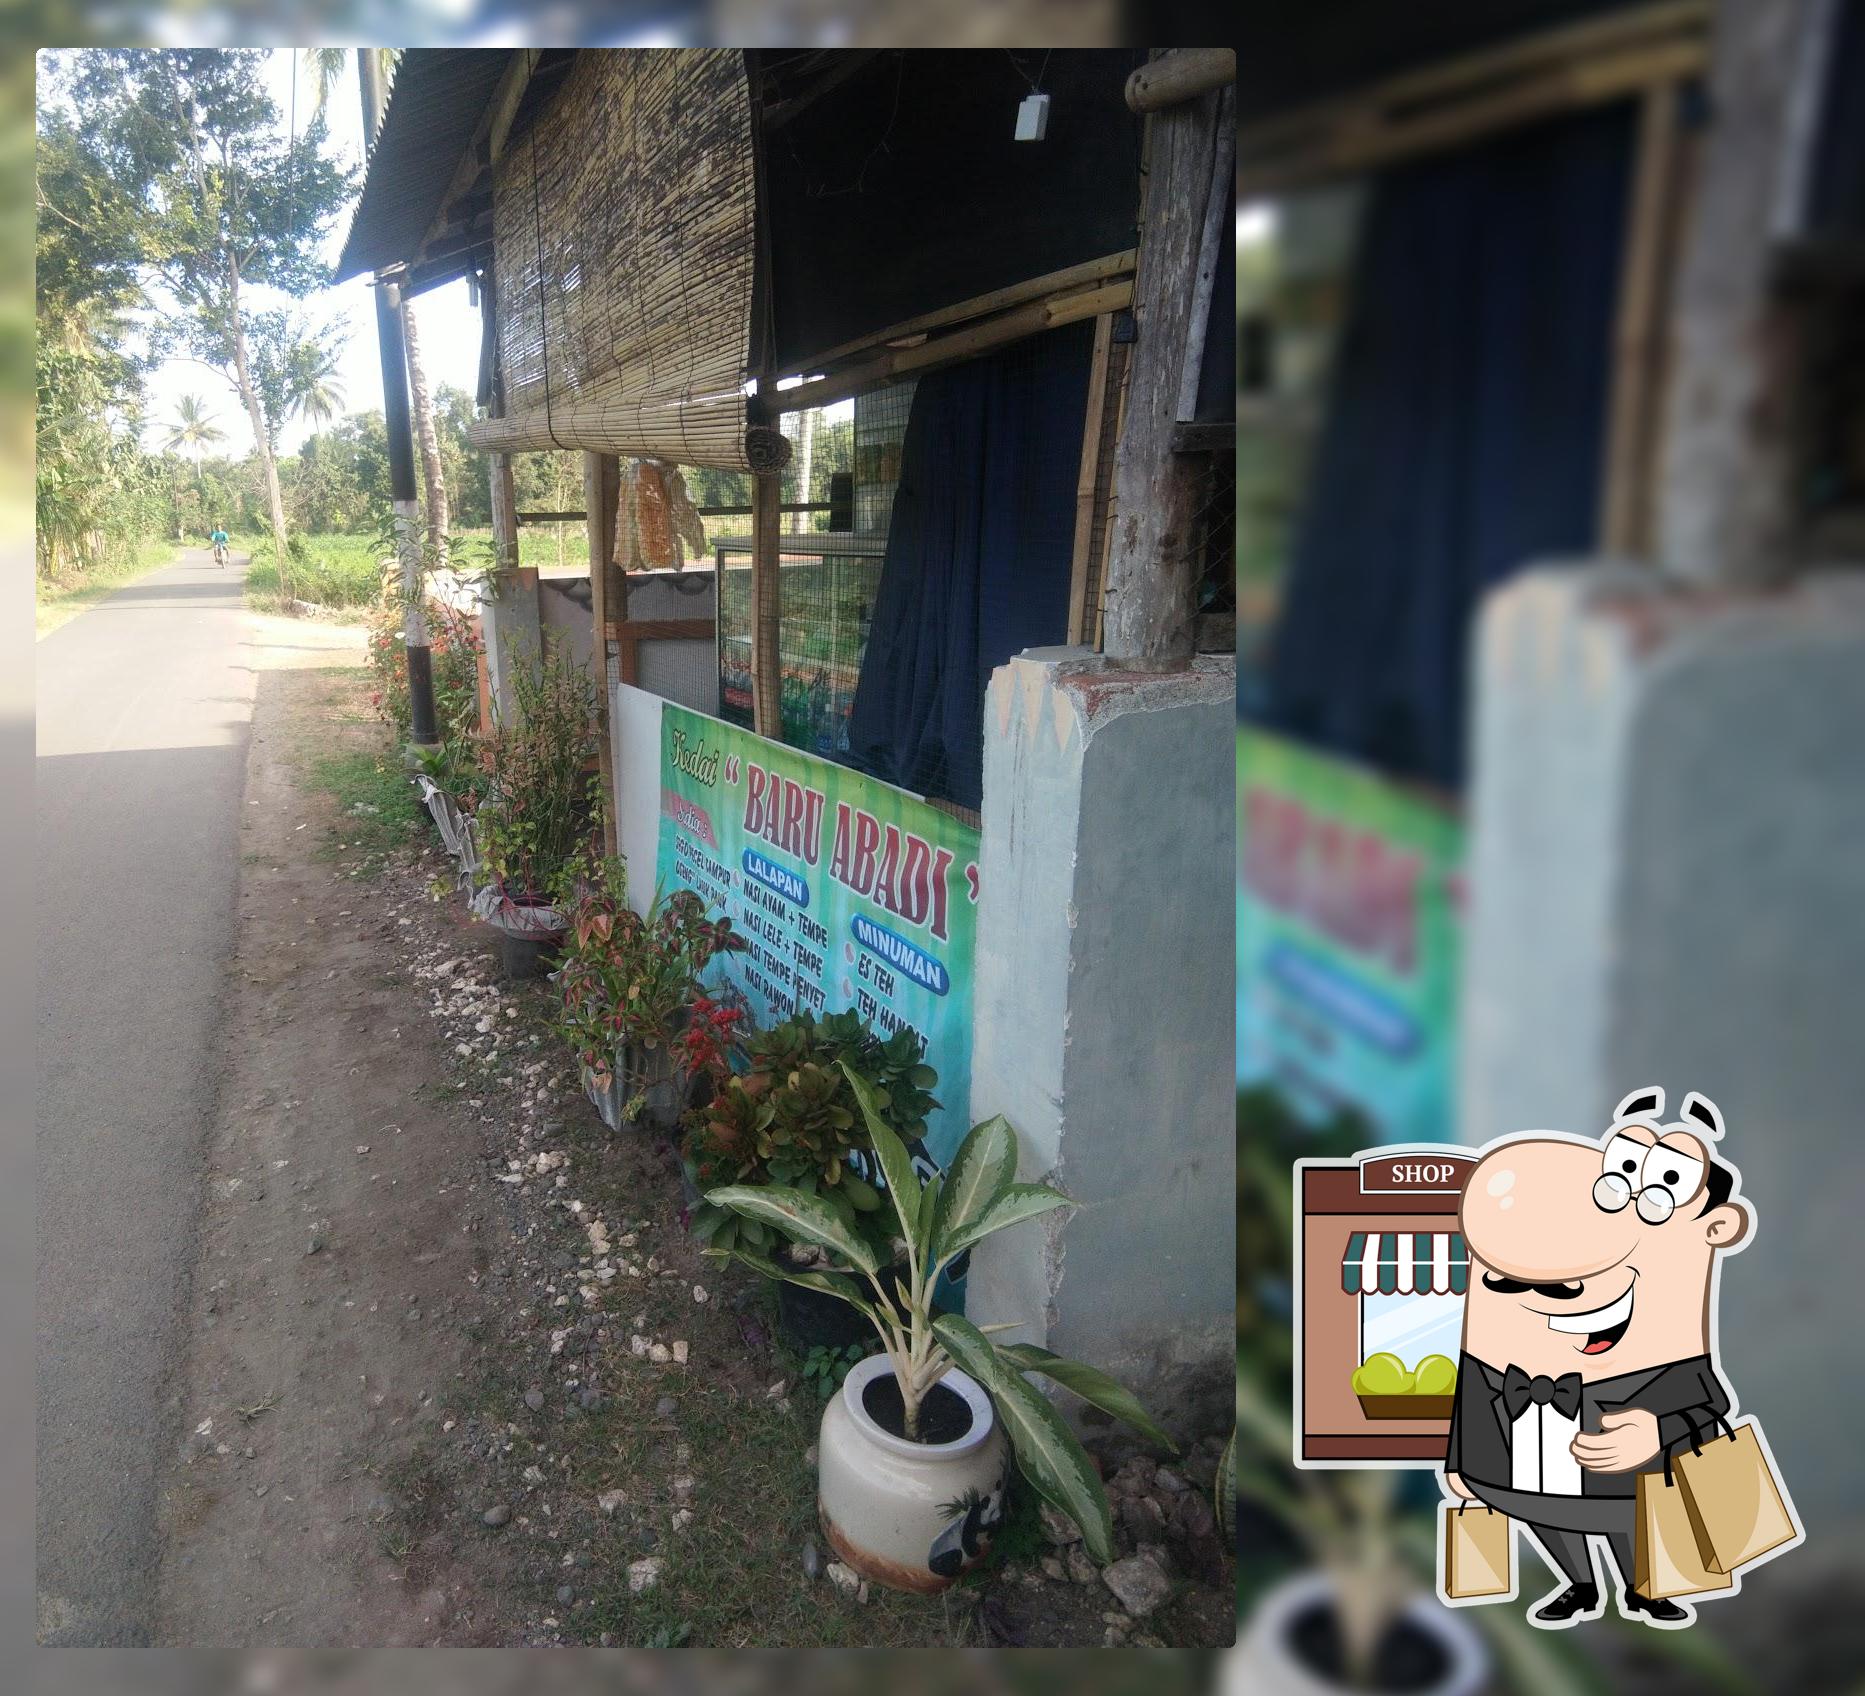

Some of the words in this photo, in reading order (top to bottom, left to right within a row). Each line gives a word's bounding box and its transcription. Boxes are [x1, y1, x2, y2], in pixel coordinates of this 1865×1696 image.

[672, 729, 719, 787] Kedai
[743, 763, 826, 868] BARU
[829, 801, 954, 944] ABADI
[748, 854, 803, 900] LALAPAN
[743, 909, 760, 933] NASI
[763, 921, 782, 948] LELE
[793, 941, 823, 977] TEMPE
[744, 879, 760, 904] NASI
[763, 892, 785, 922] AYAM
[798, 913, 828, 949] TEMPE
[764, 951, 790, 985] TEMPE
[792, 972, 826, 1010] PENYET
[858, 922, 942, 989] MINUMAN
[858, 953, 872, 979] ES
[874, 965, 894, 997] TEH
[745, 965, 761, 992] NASI
[764, 979, 794, 1015] RAWON
[858, 988, 877, 1020] TEH
[880, 1006, 928, 1059] HANT
